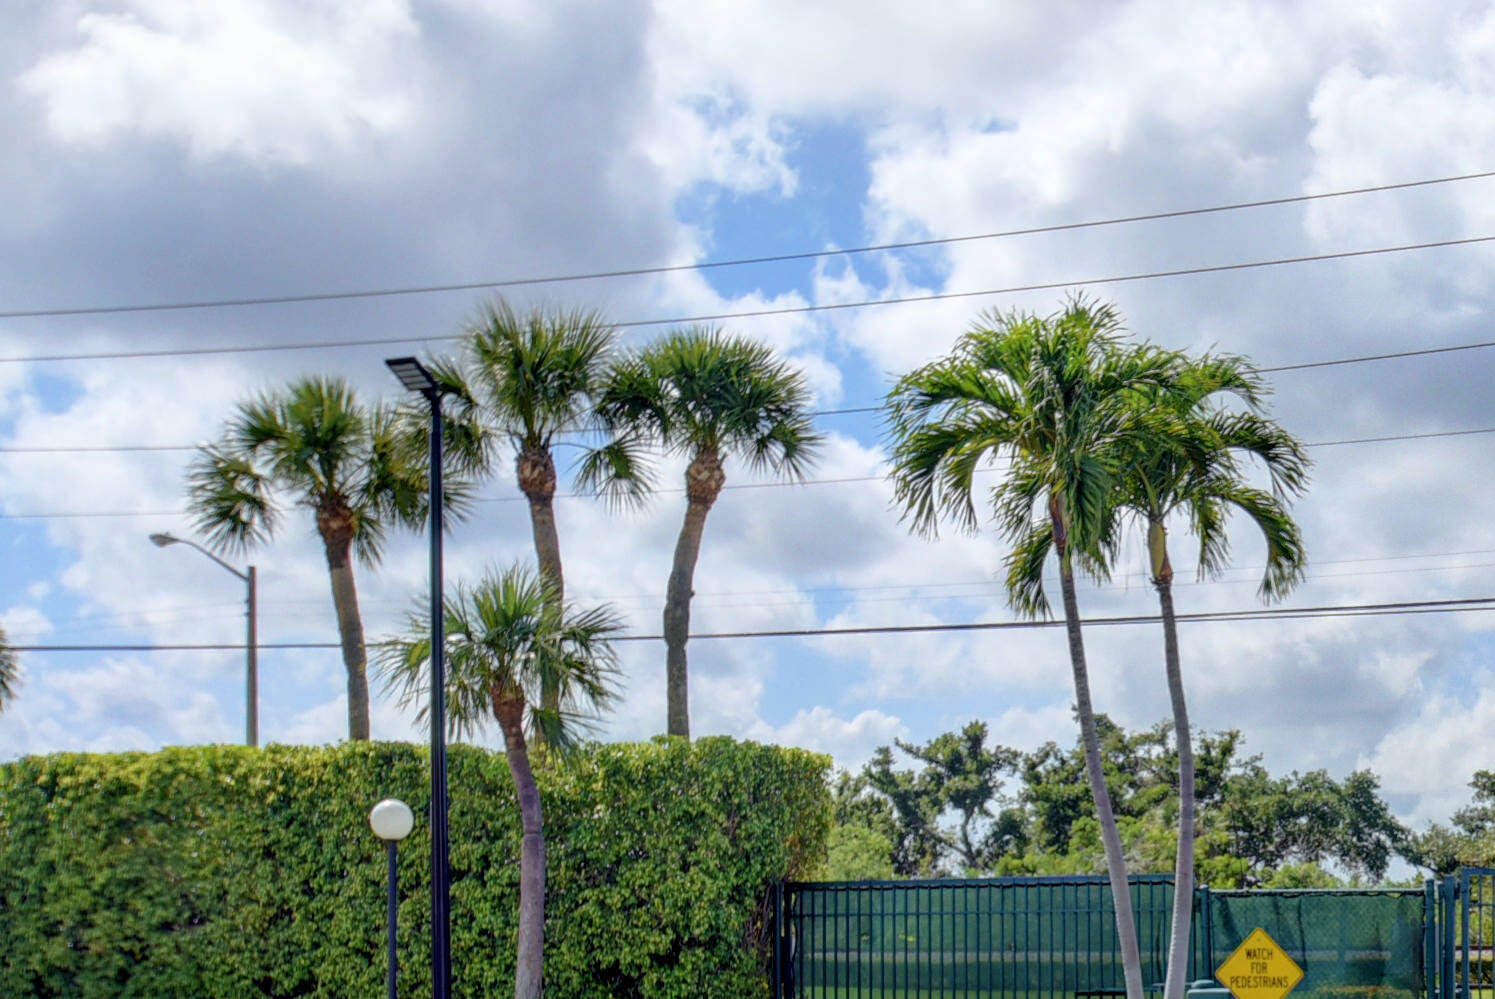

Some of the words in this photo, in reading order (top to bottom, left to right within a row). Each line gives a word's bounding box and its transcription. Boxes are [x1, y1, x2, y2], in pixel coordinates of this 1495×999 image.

[1245, 948, 1273, 960] WATCH
[1250, 961, 1268, 974] FOR
[1230, 975, 1289, 988] PEDESTRIANS
